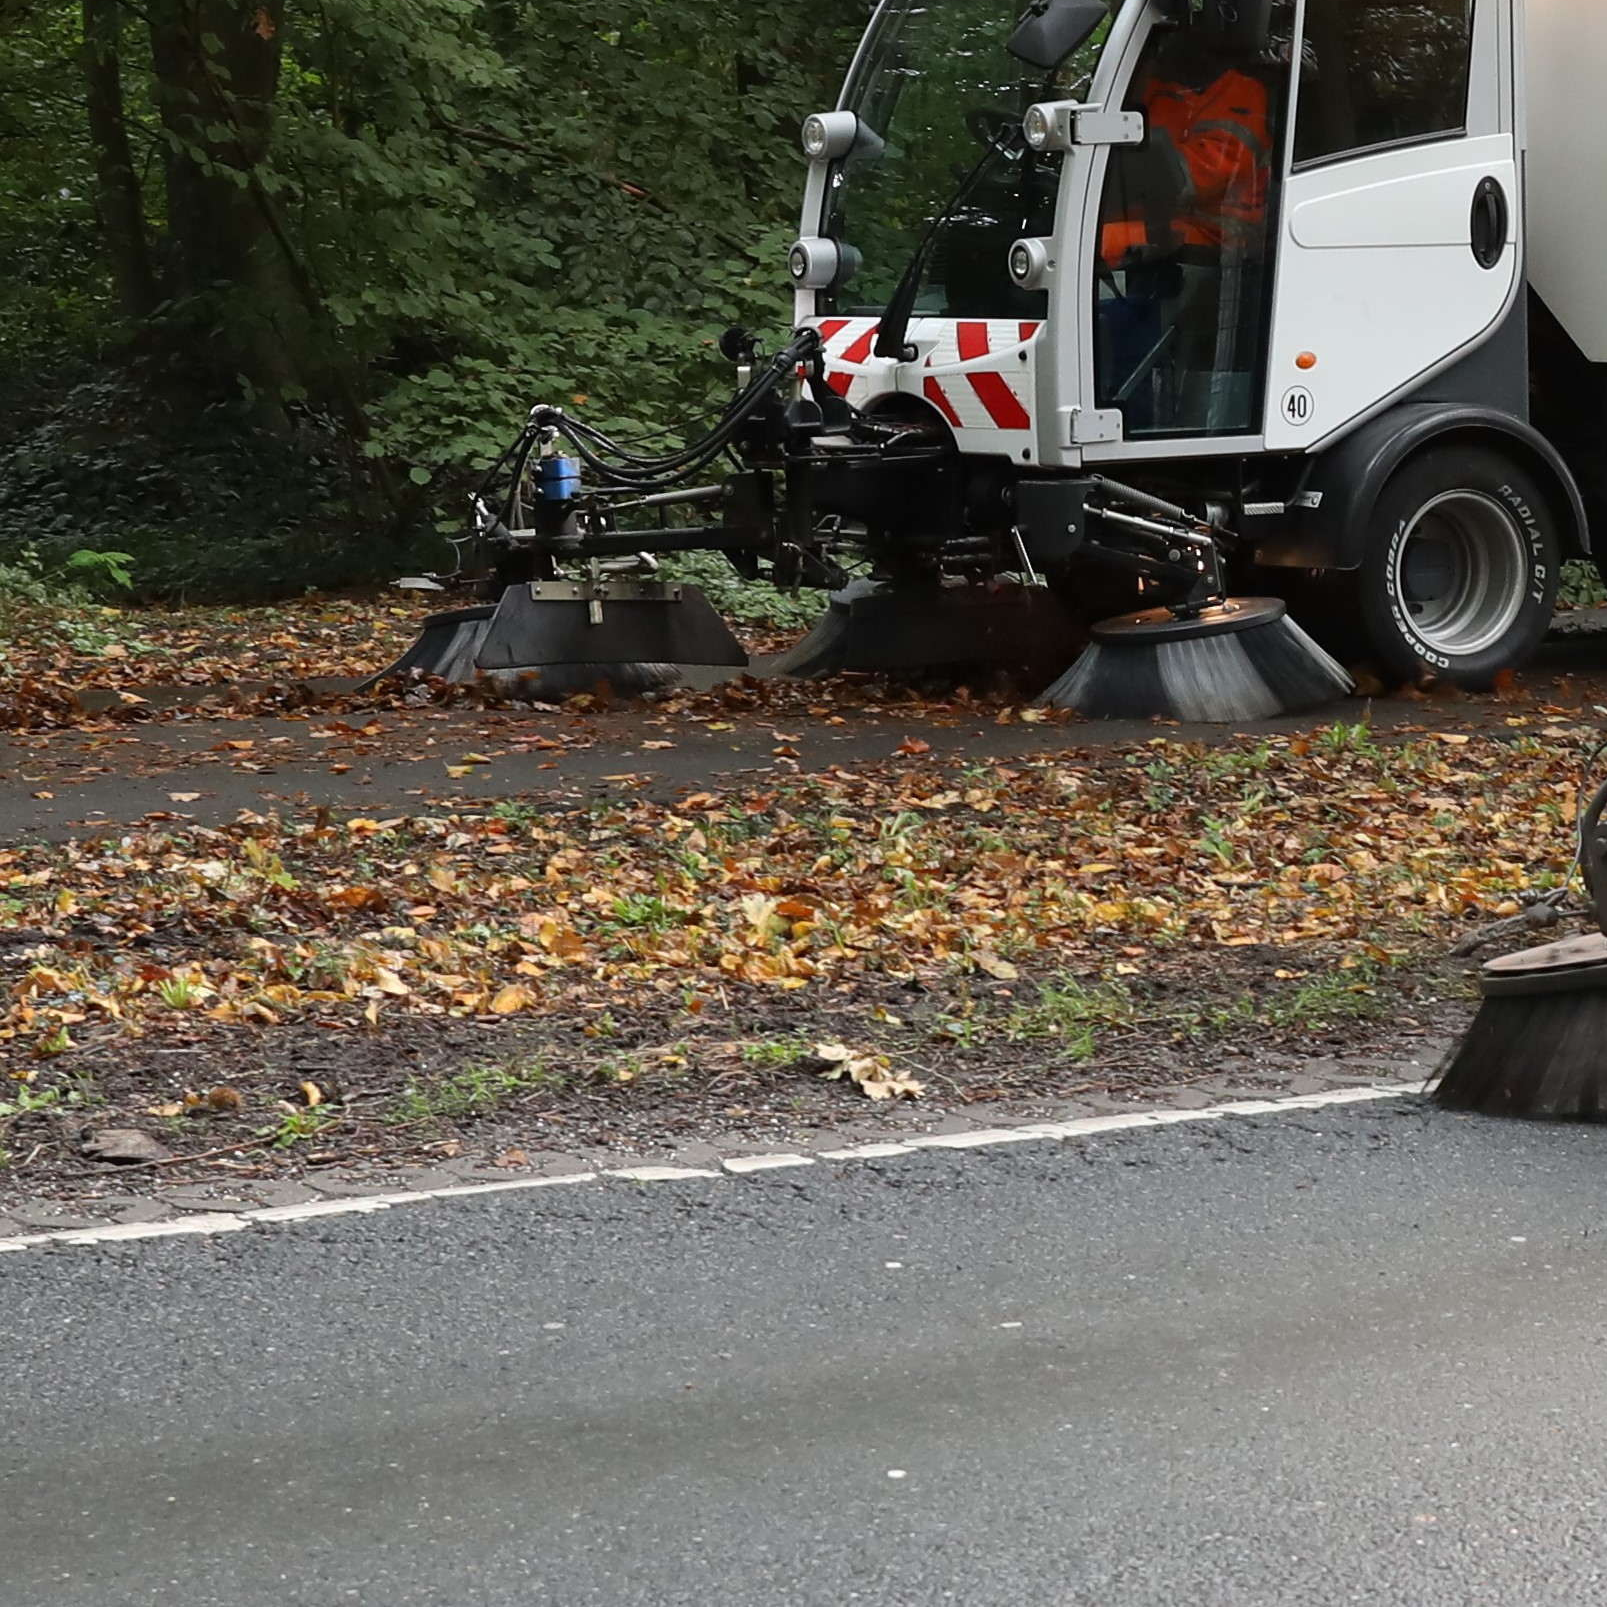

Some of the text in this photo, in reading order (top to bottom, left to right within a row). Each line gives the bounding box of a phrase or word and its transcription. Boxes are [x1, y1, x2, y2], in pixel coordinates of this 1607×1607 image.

[1287, 394, 1307, 419] 40
[1497, 484, 1546, 605] RADIAL G/T
[1391, 605, 1451, 669] COOPER
